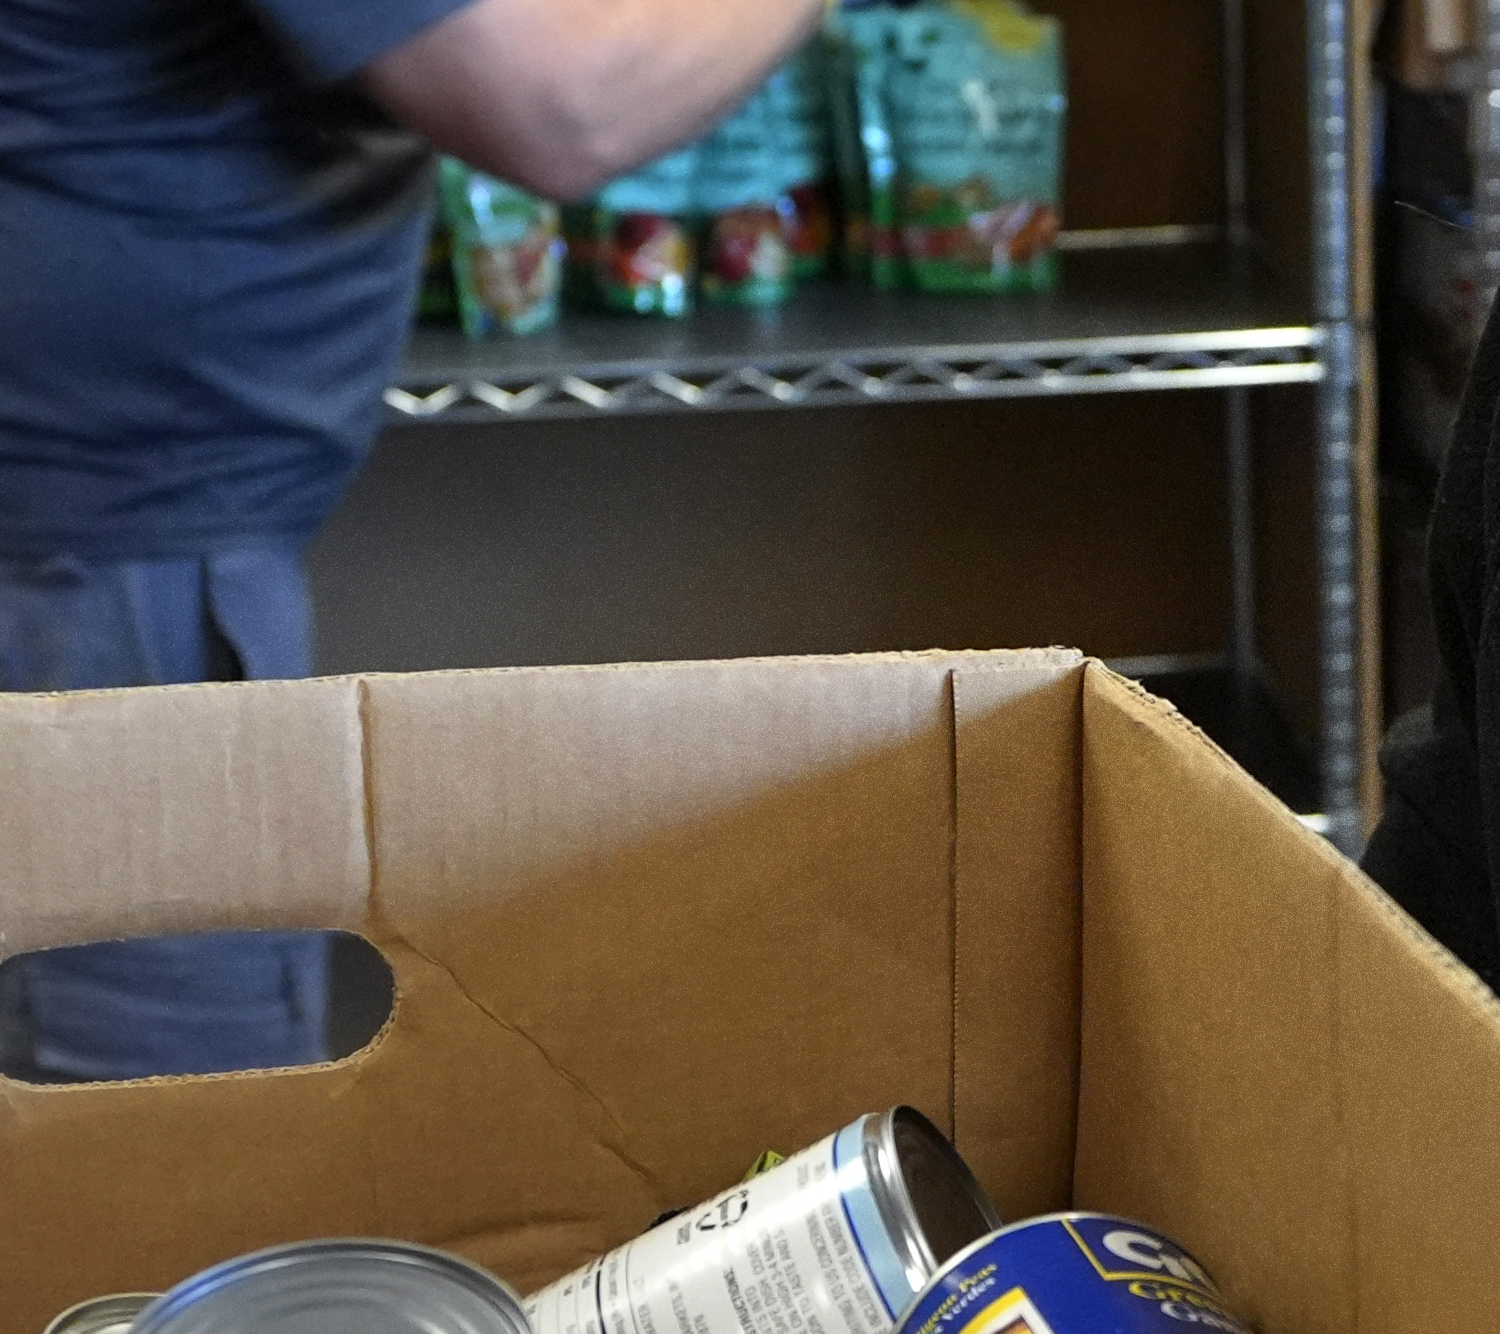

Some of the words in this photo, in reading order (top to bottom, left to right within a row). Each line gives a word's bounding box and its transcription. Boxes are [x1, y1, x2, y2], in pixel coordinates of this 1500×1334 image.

[773, 1239, 793, 1262] AND
[823, 1214, 849, 1257] NUMBER
[781, 1261, 807, 1297] TASTE
[822, 1267, 840, 1286] US
[838, 1254, 862, 1285] CODE
[956, 1260, 998, 1292] Peas
[741, 1284, 764, 1314] INTO
[772, 1279, 795, 1311] HIGH
[796, 1296, 813, 1314] TO
[829, 1282, 847, 1301] TO
[851, 1282, 883, 1329] INCLUDE
[940, 1274, 998, 1323] Verdes
[767, 1305, 789, 1334] SAFE
[785, 1309, 803, 1330] ON
